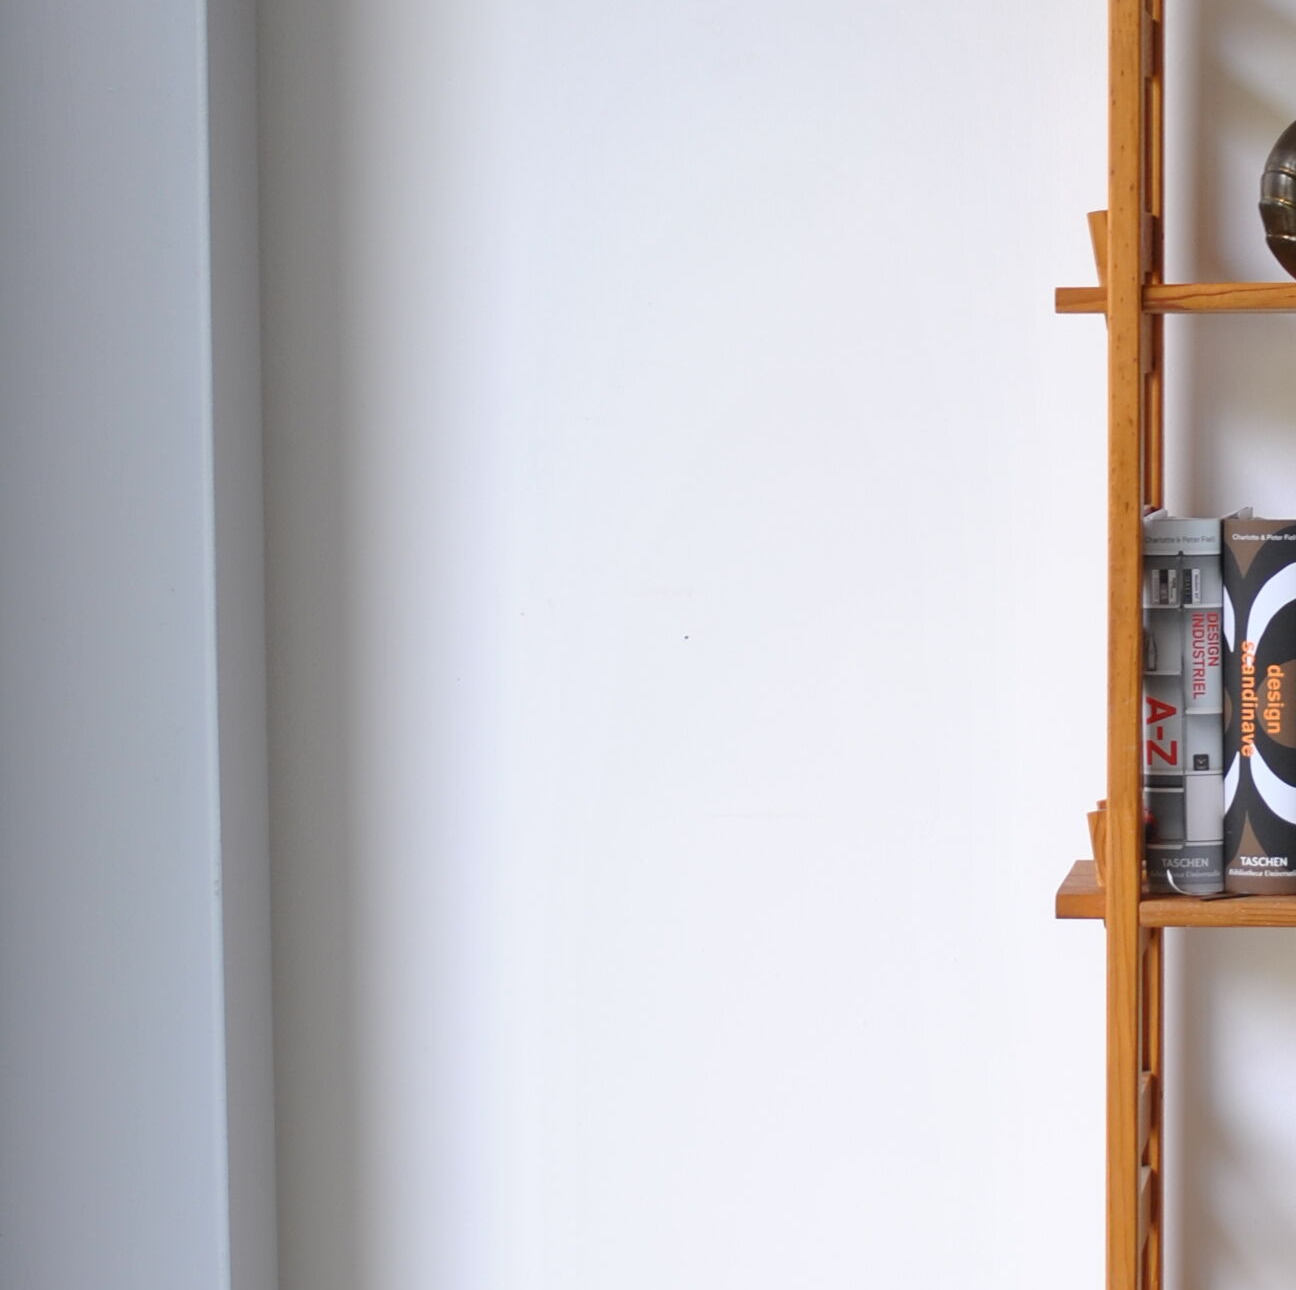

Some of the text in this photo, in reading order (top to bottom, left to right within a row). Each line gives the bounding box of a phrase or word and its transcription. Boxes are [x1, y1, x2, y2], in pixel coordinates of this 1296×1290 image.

[1192, 612, 1206, 700] INDUSTRIEL
[1206, 612, 1219, 667] DESIGN
[1145, 696, 1178, 766] A-Z
[1241, 640, 1259, 758] scandinave
[1262, 664, 1285, 735] design
[1160, 857, 1209, 868] TASCHEN
[1239, 856, 1288, 867] TASCHEN
